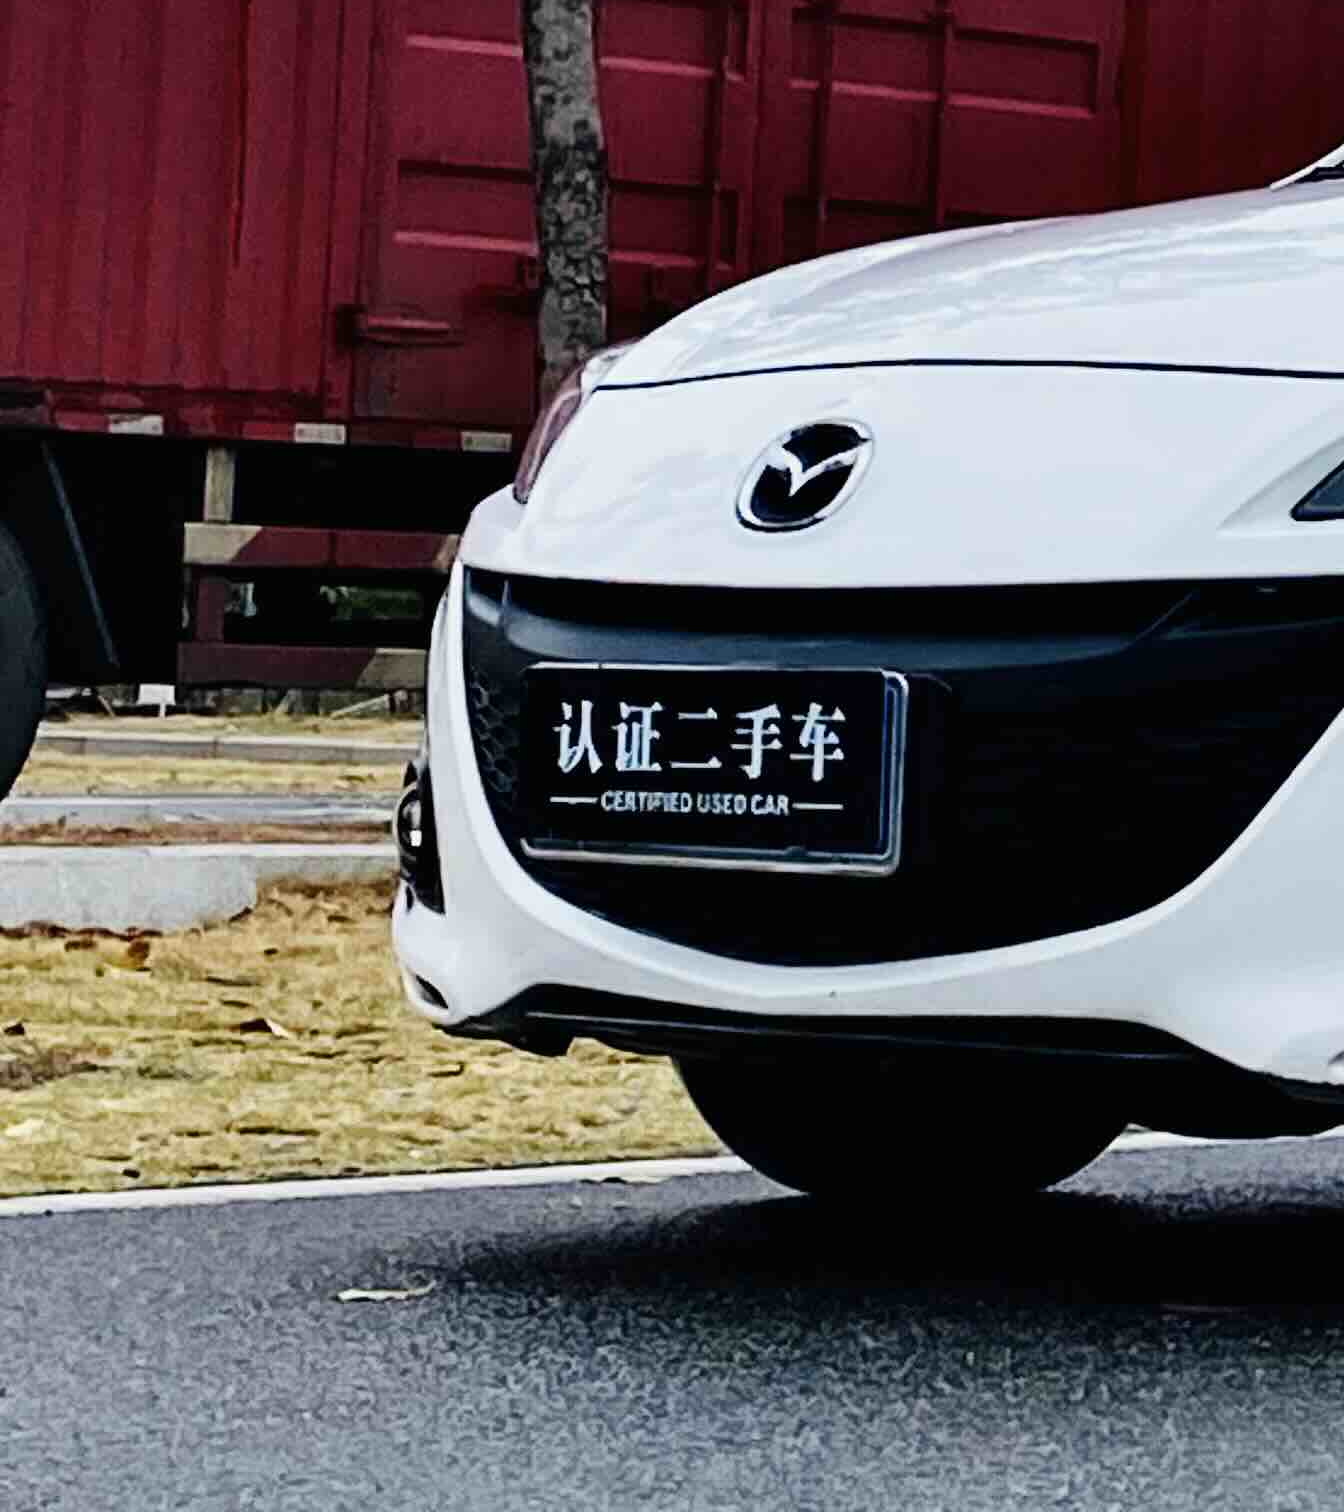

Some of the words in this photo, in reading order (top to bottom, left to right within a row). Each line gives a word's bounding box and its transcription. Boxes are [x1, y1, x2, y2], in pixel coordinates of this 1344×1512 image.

[552, 699, 846, 782] 认证二手车
[601, 790, 692, 813] CERTIFIED
[697, 792, 747, 815] USED
[751, 794, 789, 815] CAR
